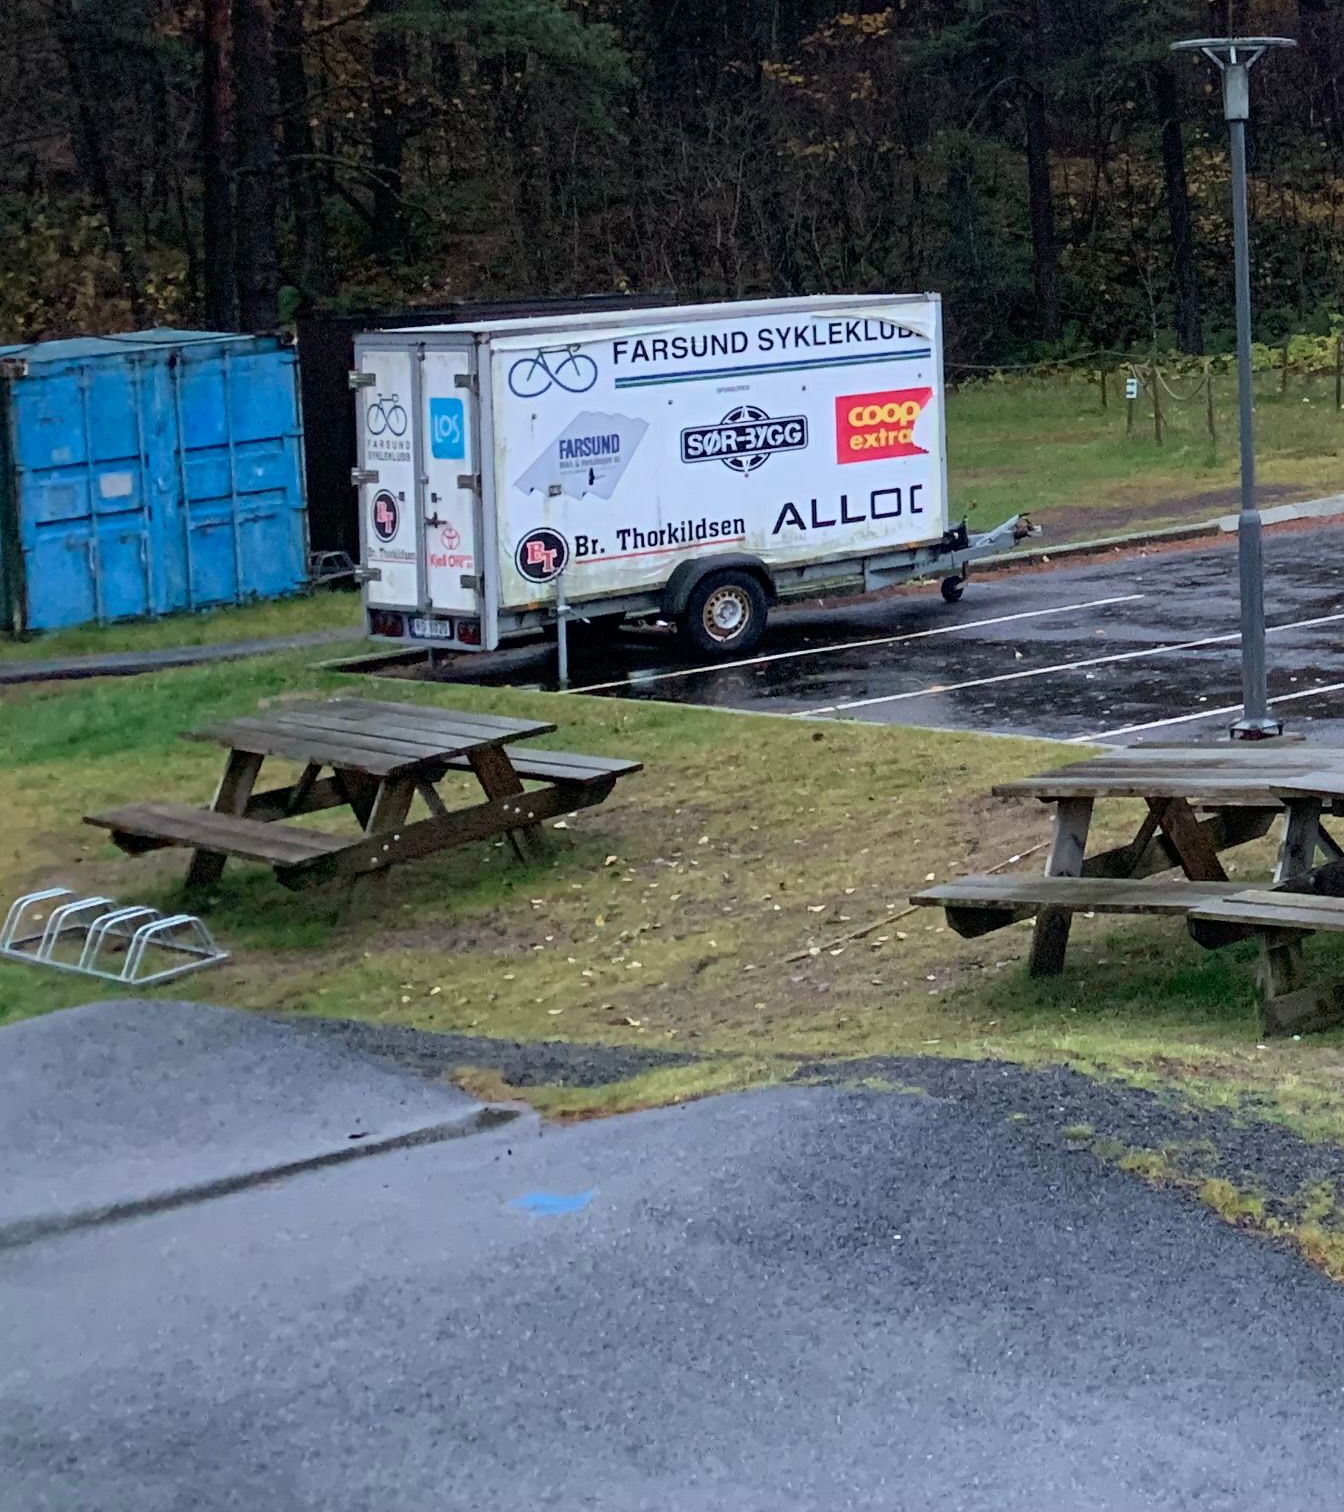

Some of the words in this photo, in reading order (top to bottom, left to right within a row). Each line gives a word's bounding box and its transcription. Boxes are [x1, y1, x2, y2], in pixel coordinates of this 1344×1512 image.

[613, 331, 748, 365] FARSUND
[758, 319, 924, 351] SYKLEKLUB
[848, 400, 921, 427] coop
[434, 414, 460, 444] LOS
[687, 422, 802, 456] SØR-BYGG
[849, 428, 912, 451] extra
[367, 439, 411, 450] FARSUND
[559, 433, 620, 459] FARSUND
[574, 535, 606, 557] Br.
[616, 518, 746, 551] Thorkildsen
